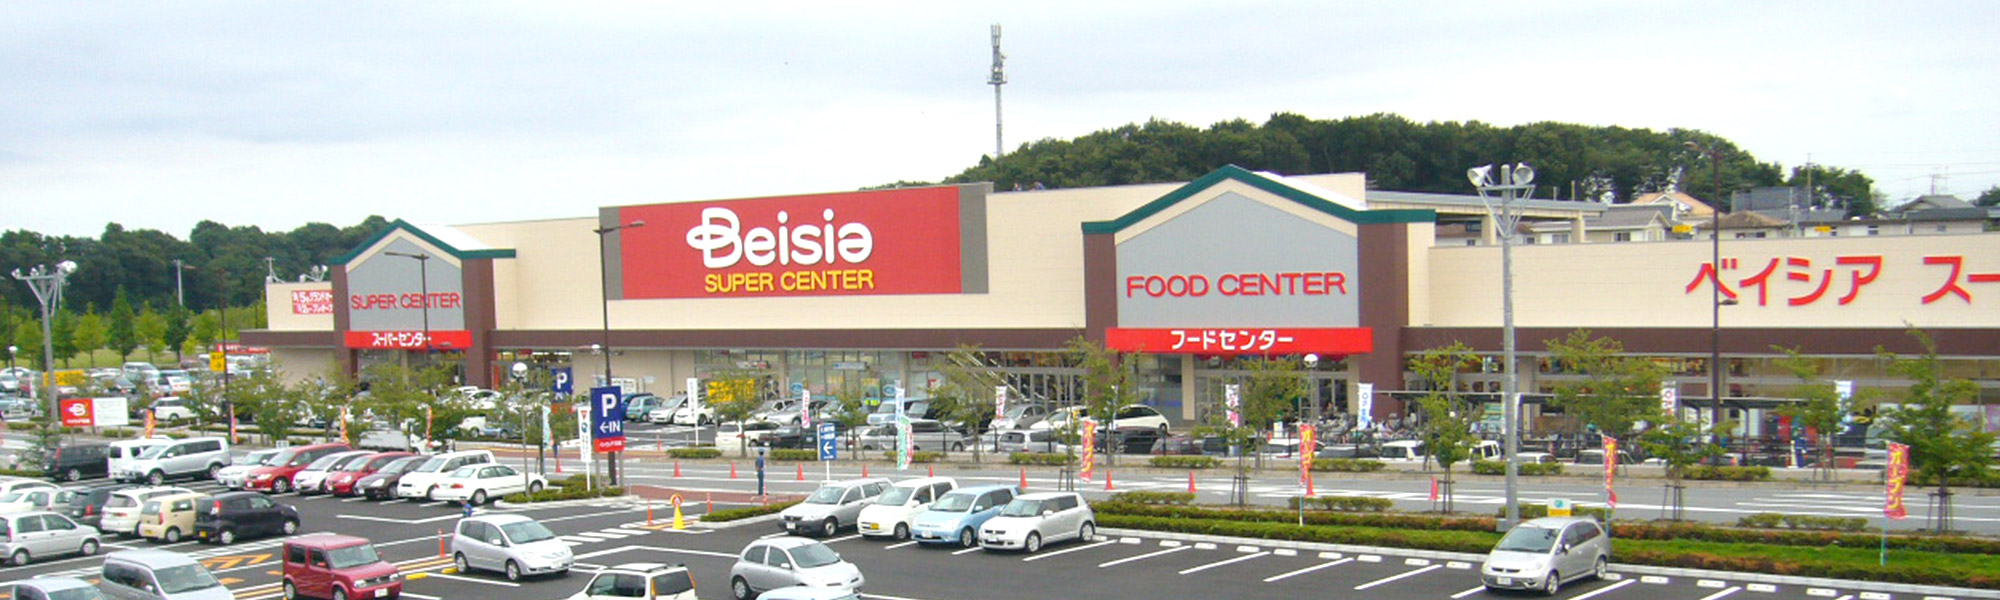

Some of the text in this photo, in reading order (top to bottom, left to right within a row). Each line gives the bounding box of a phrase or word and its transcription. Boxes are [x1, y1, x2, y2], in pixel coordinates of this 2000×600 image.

[686, 207, 873, 268] Beisia
[704, 269, 875, 293] SUPER CENTER
[1126, 272, 1346, 298] FOOD CENTER
[1686, 256, 1882, 307] ベイシア
[351, 294, 399, 310] SUPER
[401, 292, 462, 309] CENTER
[371, 332, 432, 347] スーパーセンター
[1170, 329, 1294, 350] フードセンター
[556, 372, 568, 389] P
[601, 393, 617, 418] P
[609, 420, 621, 433] IN
[1888, 451, 1905, 509] オープン
